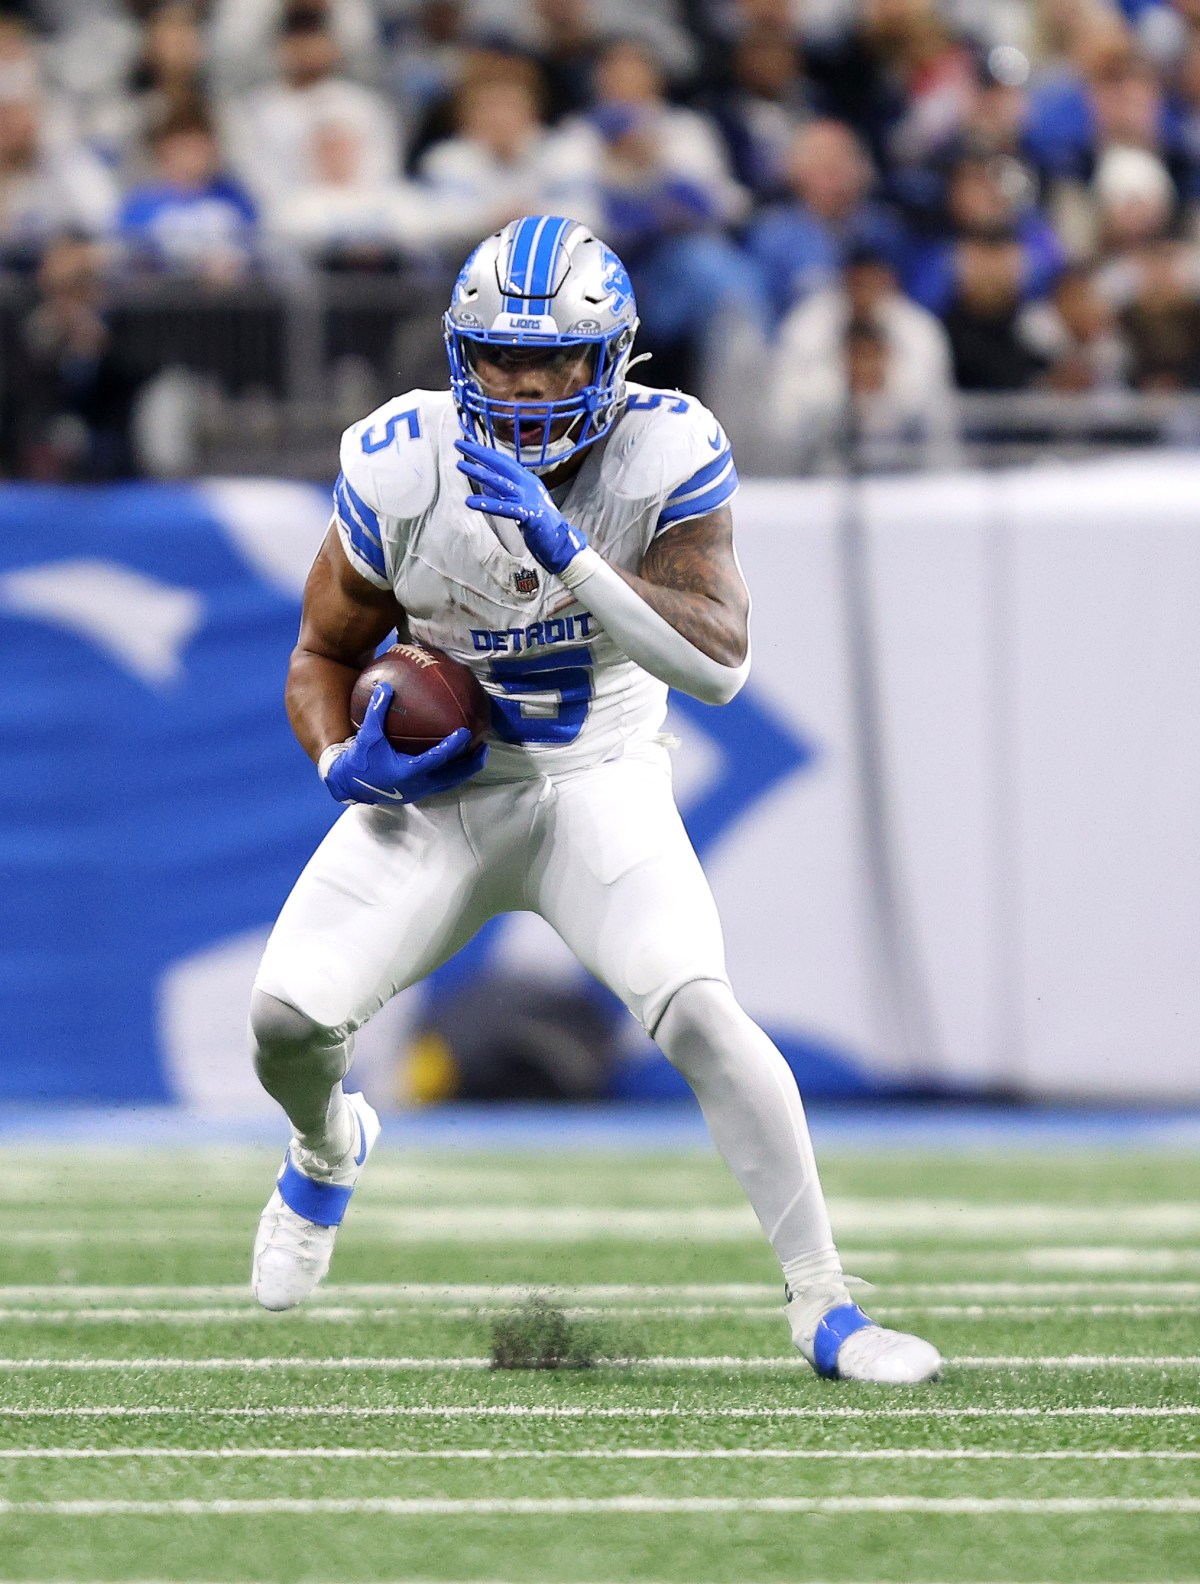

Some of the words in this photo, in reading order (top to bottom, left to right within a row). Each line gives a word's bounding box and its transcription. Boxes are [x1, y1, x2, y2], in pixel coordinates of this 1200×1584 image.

[361, 408, 420, 454] 5
[469, 611, 593, 651] DETROIT
[487, 644, 595, 747] 5
